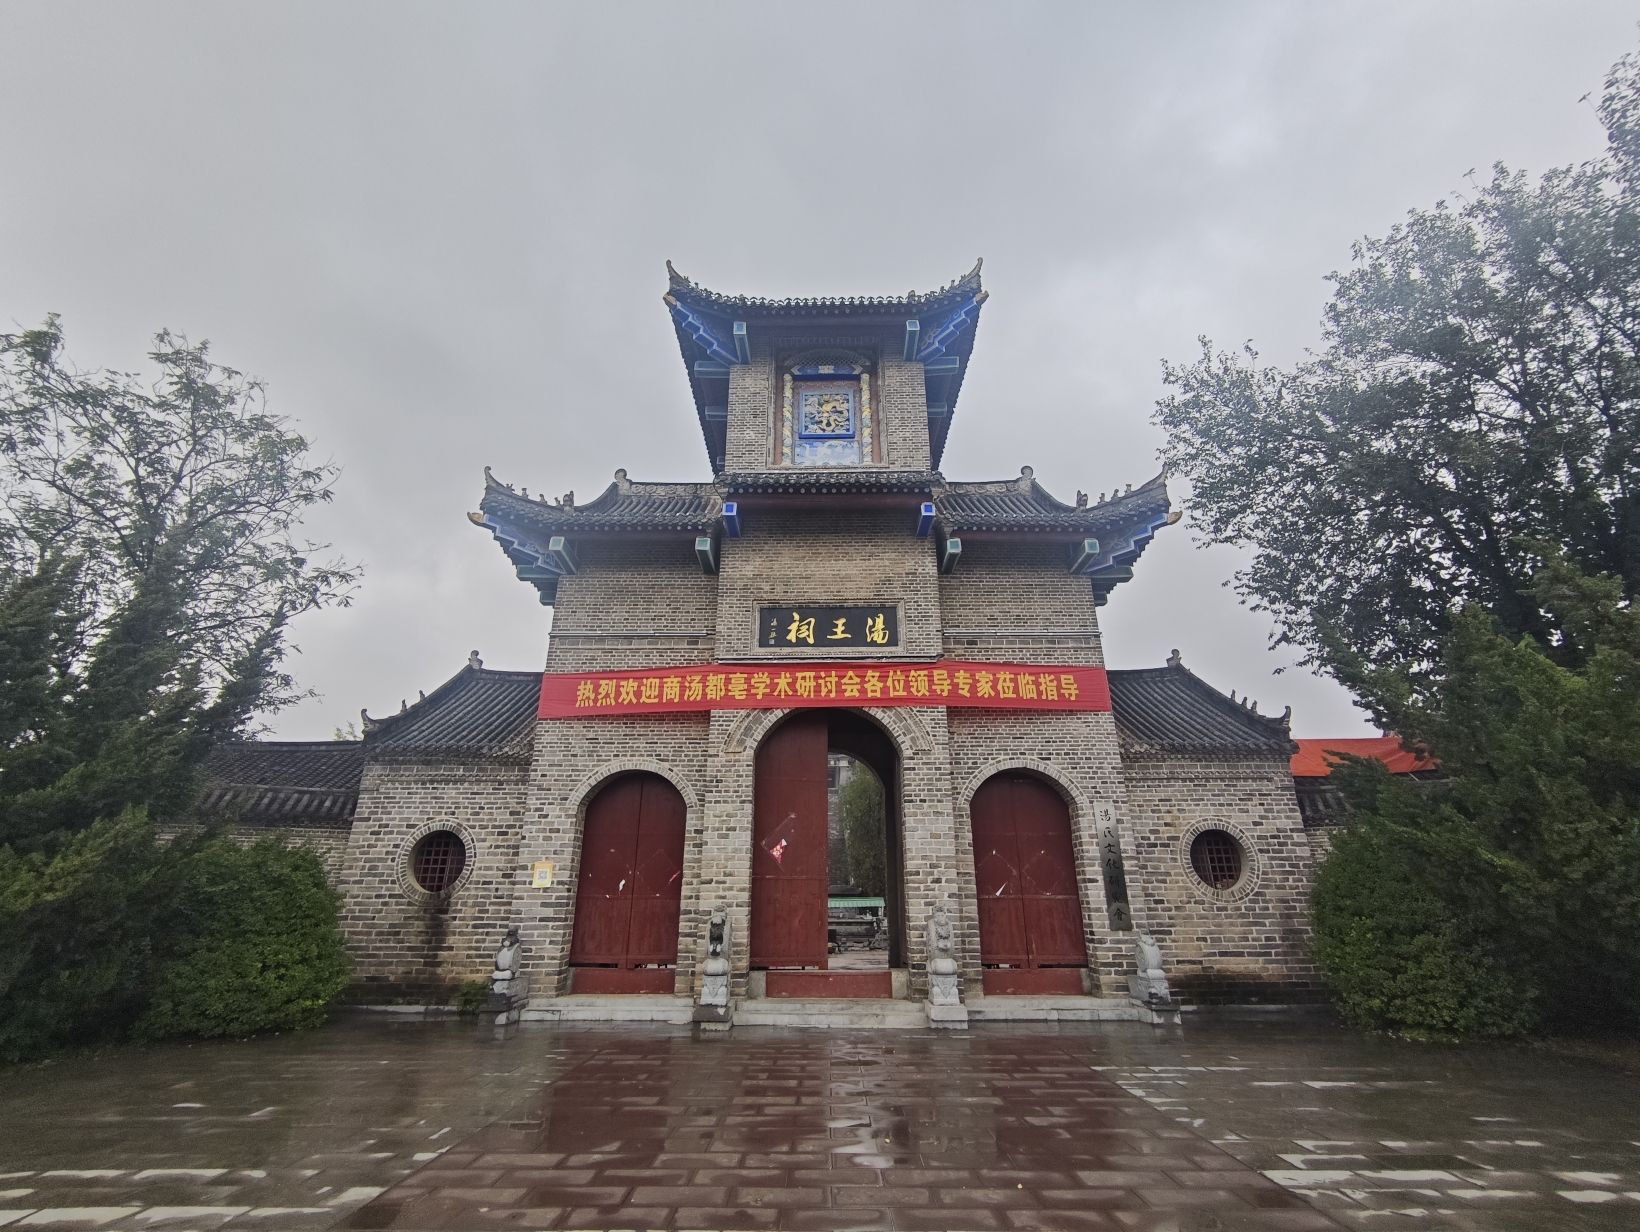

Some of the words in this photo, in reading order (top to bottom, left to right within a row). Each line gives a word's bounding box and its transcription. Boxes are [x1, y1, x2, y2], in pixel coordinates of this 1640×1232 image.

[576, 669, 1079, 707] 热烈欢迎商汤都亳学术研讨会各位领导专家莅临指导
